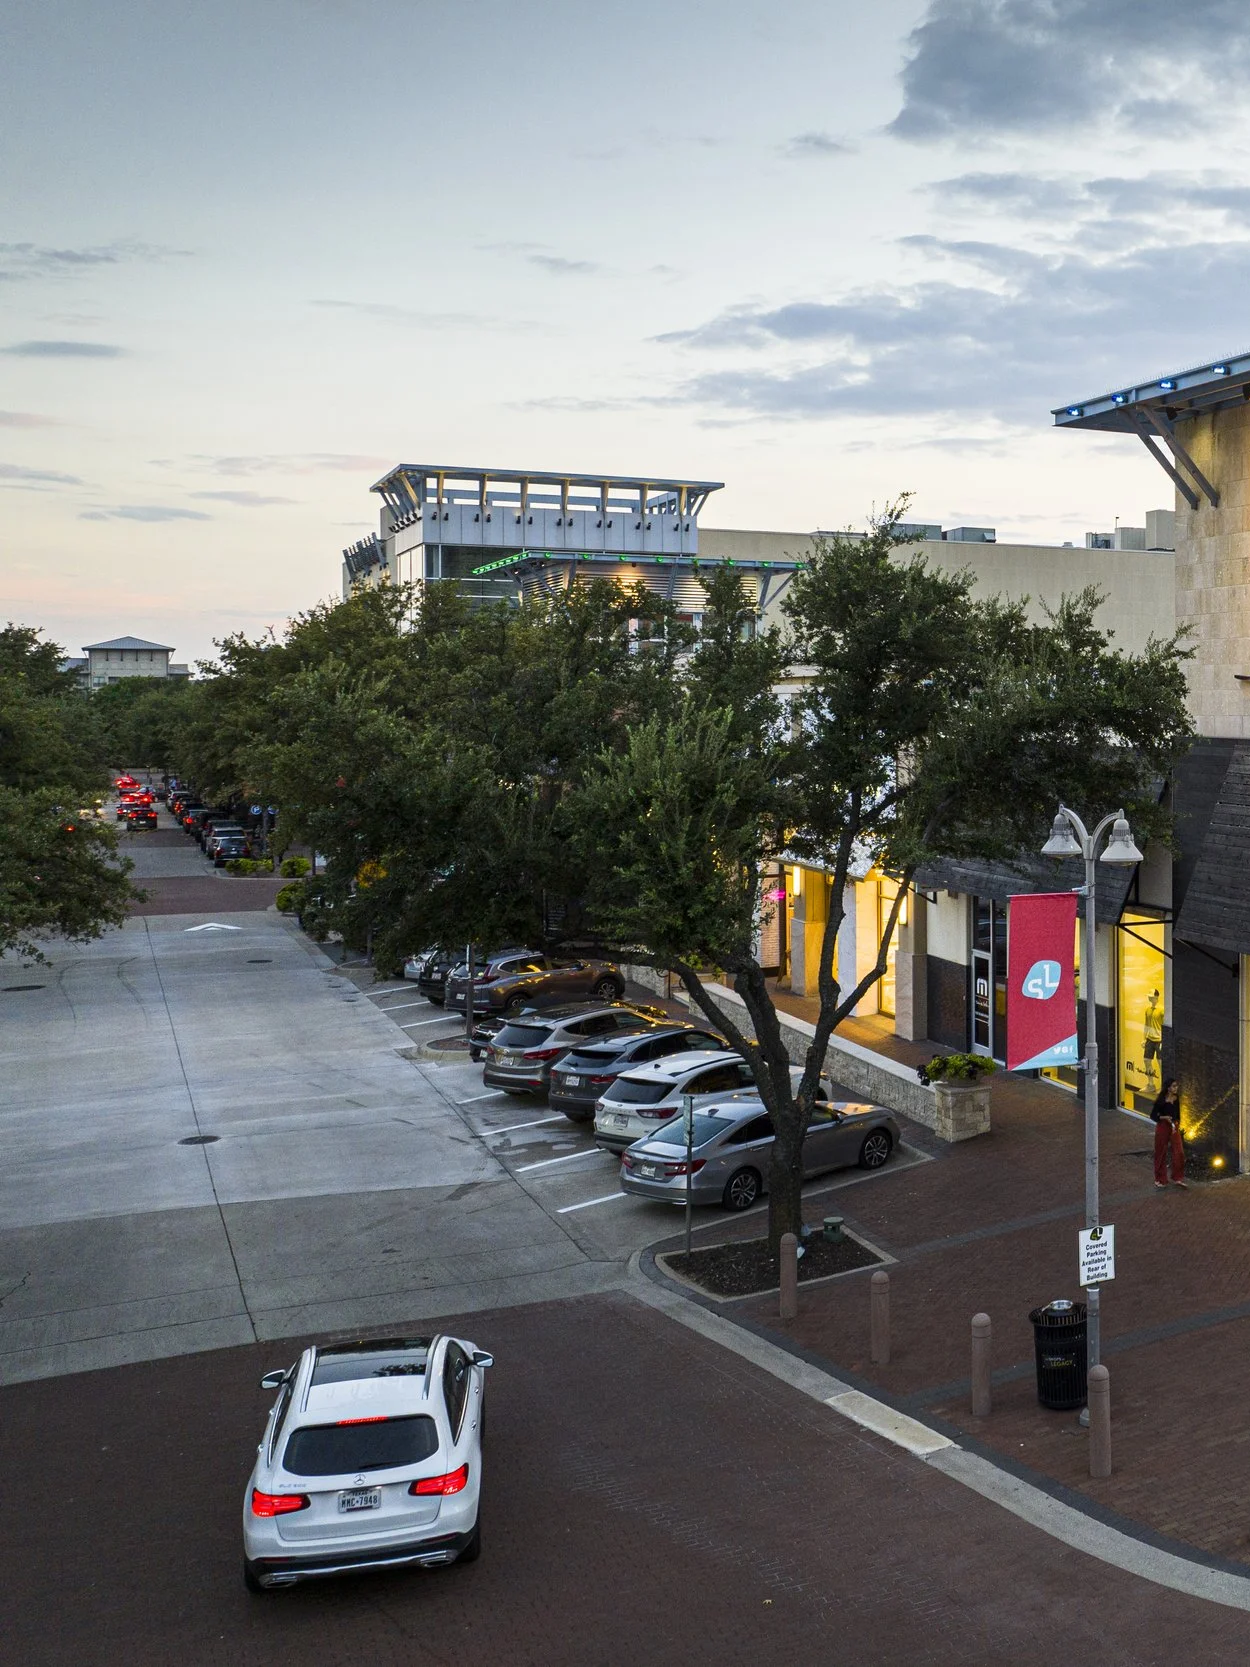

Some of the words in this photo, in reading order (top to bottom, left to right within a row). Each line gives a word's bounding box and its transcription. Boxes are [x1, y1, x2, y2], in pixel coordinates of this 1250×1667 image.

[1086, 1241, 1107, 1250] Covered
[1082, 1257, 1105, 1266] Available
[1086, 1272, 1107, 1280] Building
